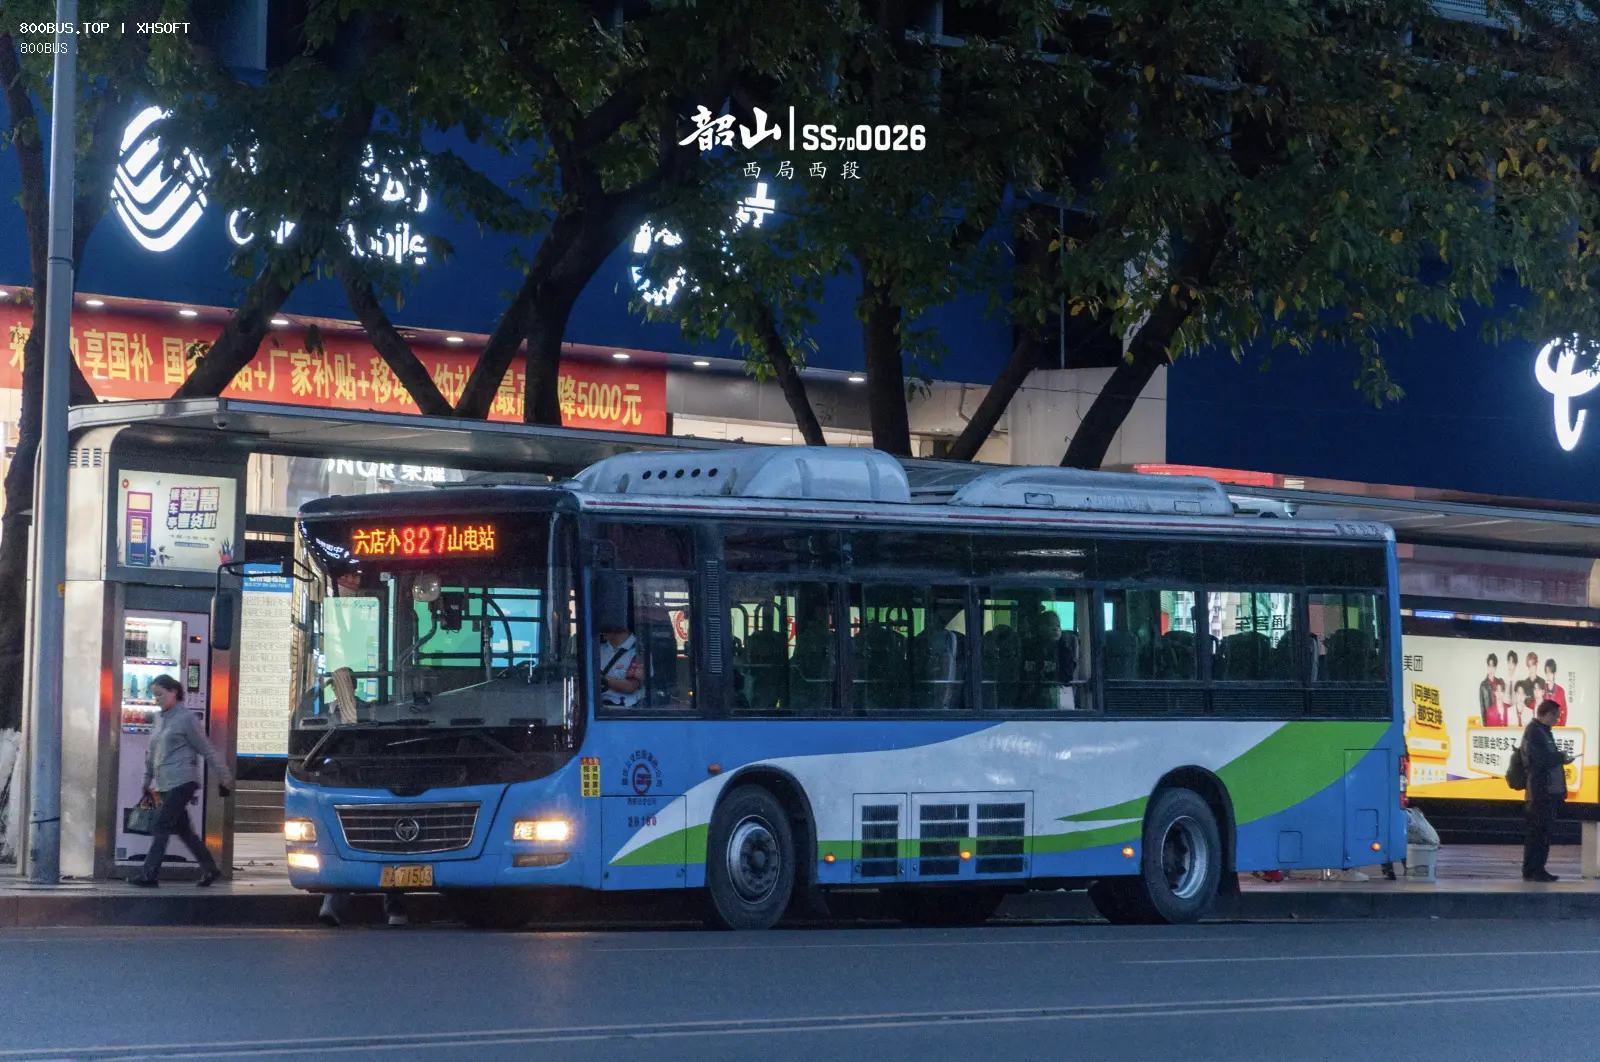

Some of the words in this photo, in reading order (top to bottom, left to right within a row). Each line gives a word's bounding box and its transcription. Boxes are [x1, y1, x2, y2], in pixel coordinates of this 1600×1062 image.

[353, 529, 401, 555] 六店小
[403, 526, 446, 555] 827
[1403, 655, 1423, 672] 美团
